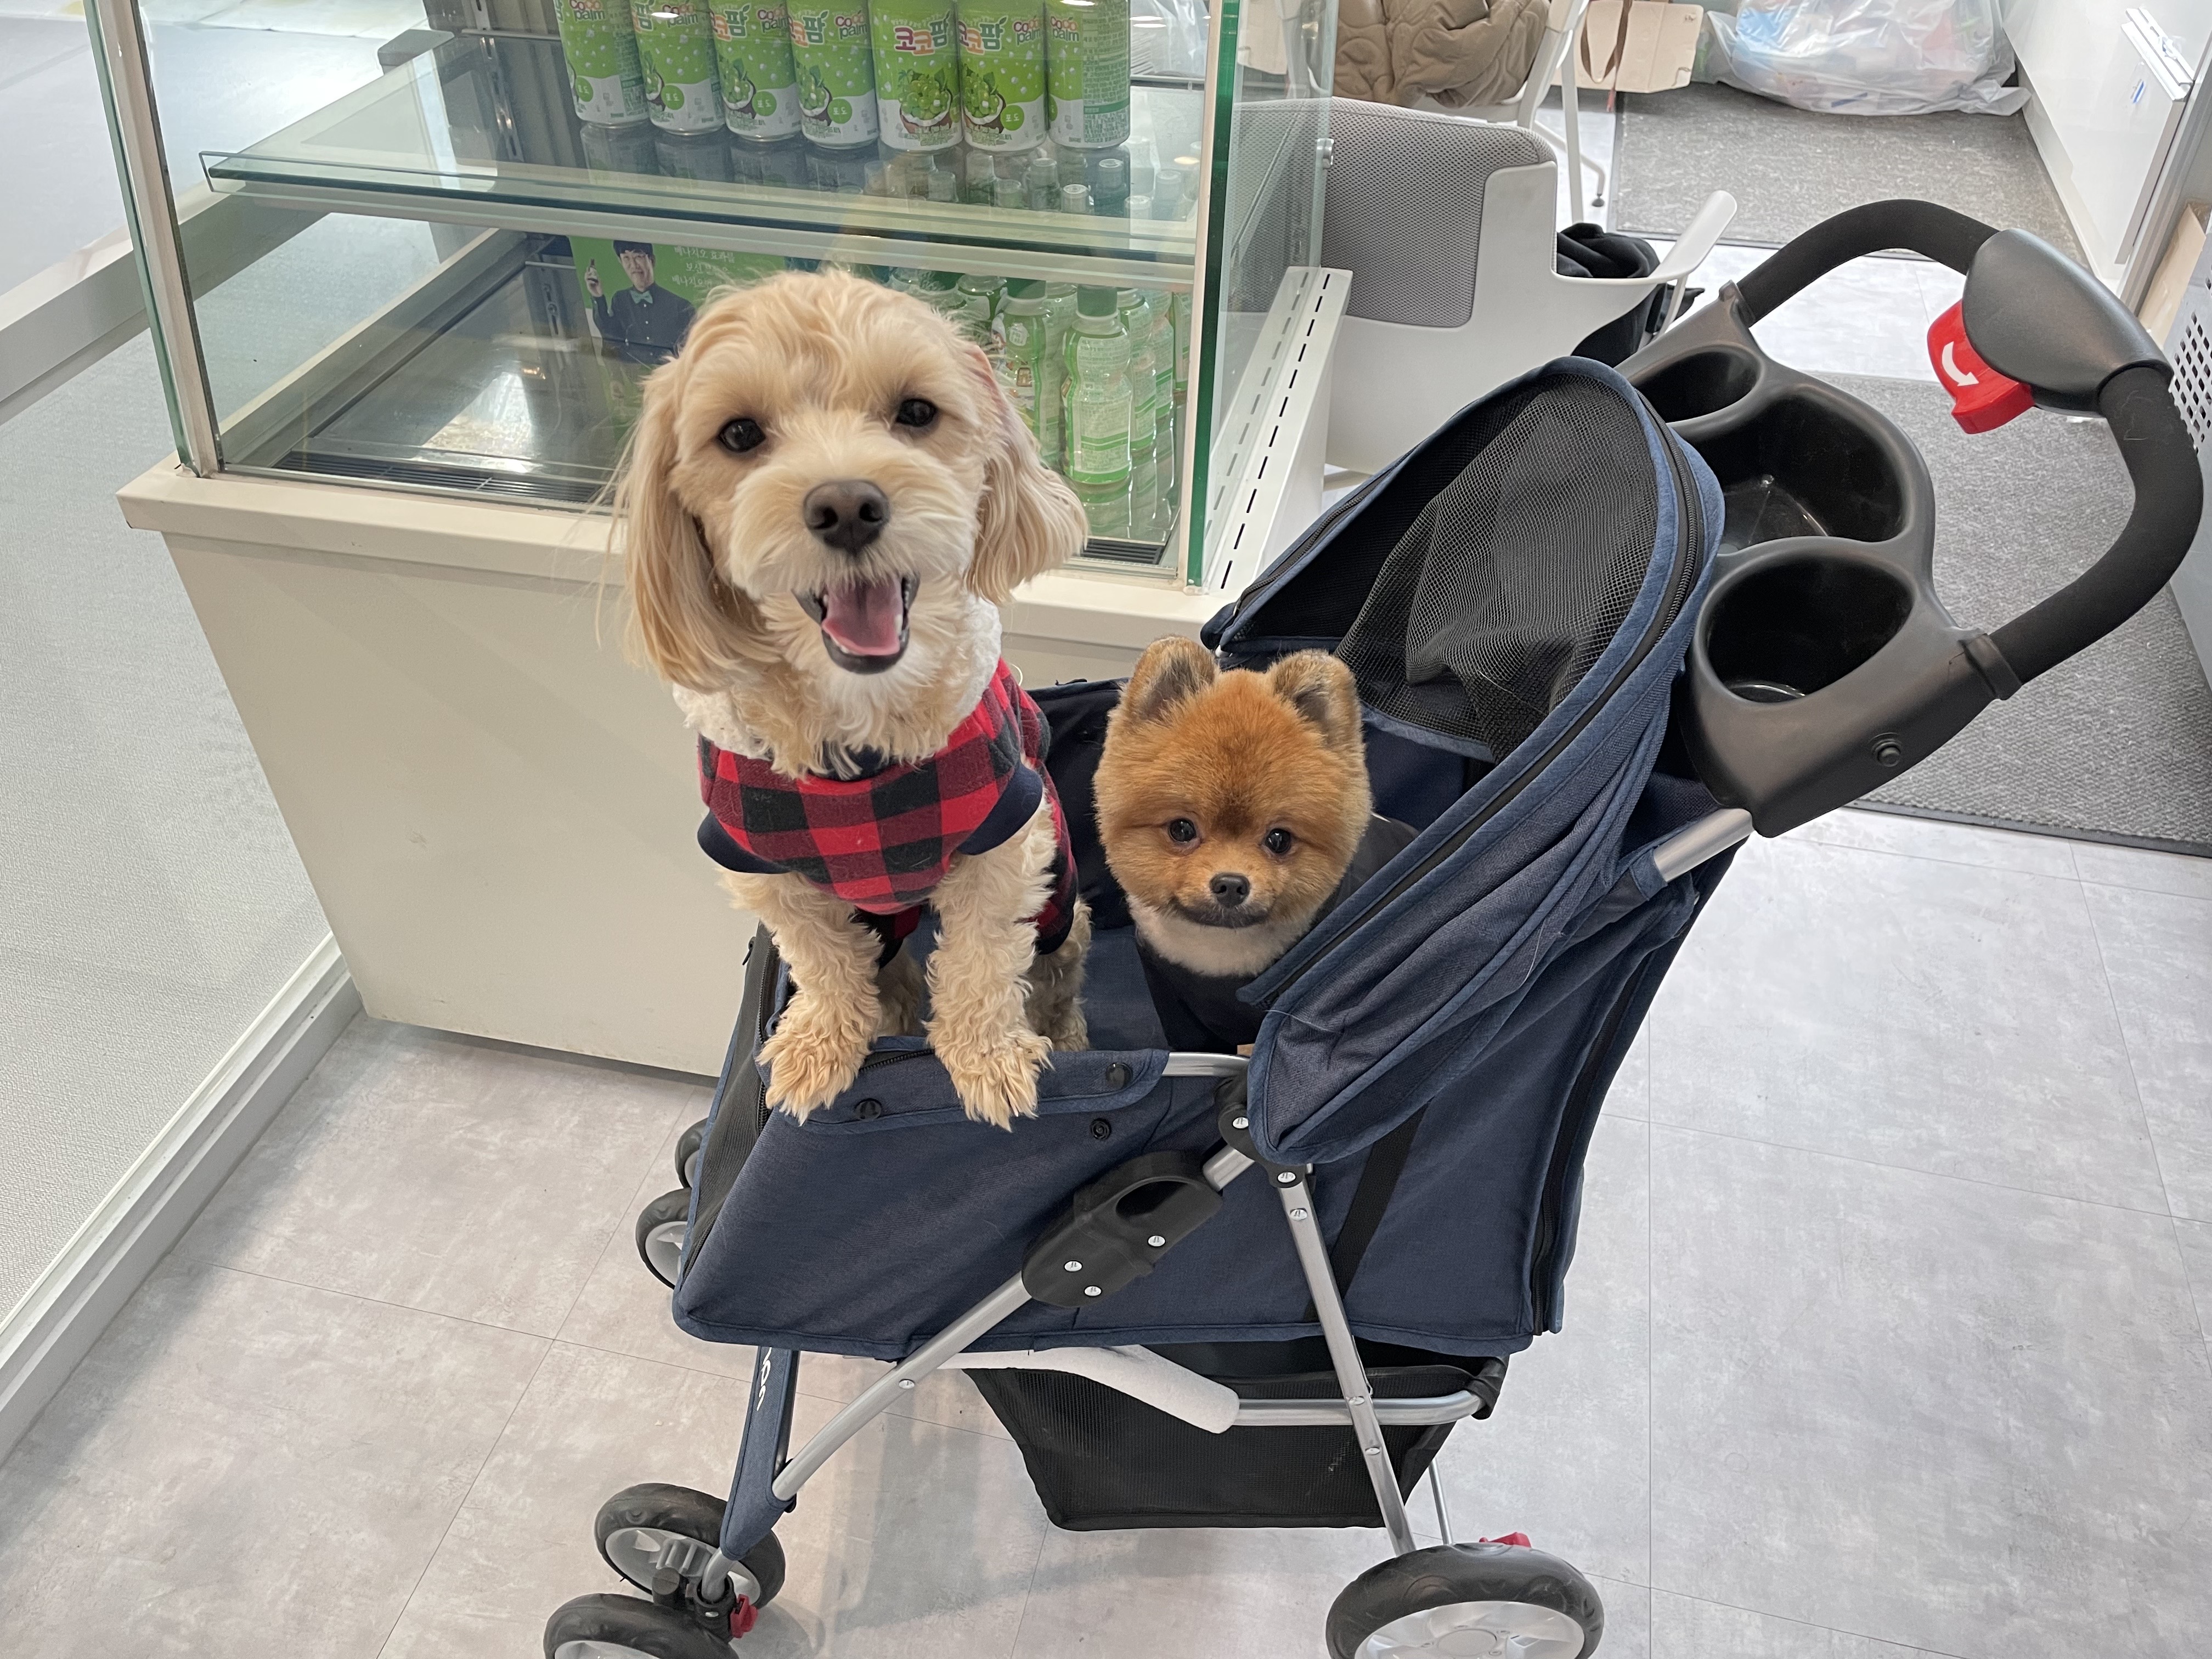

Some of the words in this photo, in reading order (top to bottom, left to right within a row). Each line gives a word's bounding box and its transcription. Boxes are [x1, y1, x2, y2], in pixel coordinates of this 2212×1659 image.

[839, 24, 867, 40] palm
[894, 19, 949, 55] 코코팜
[1017, 29, 1041, 46] palm
[1053, 29, 1080, 42] palm
[1006, 112, 1020, 122] 포도
